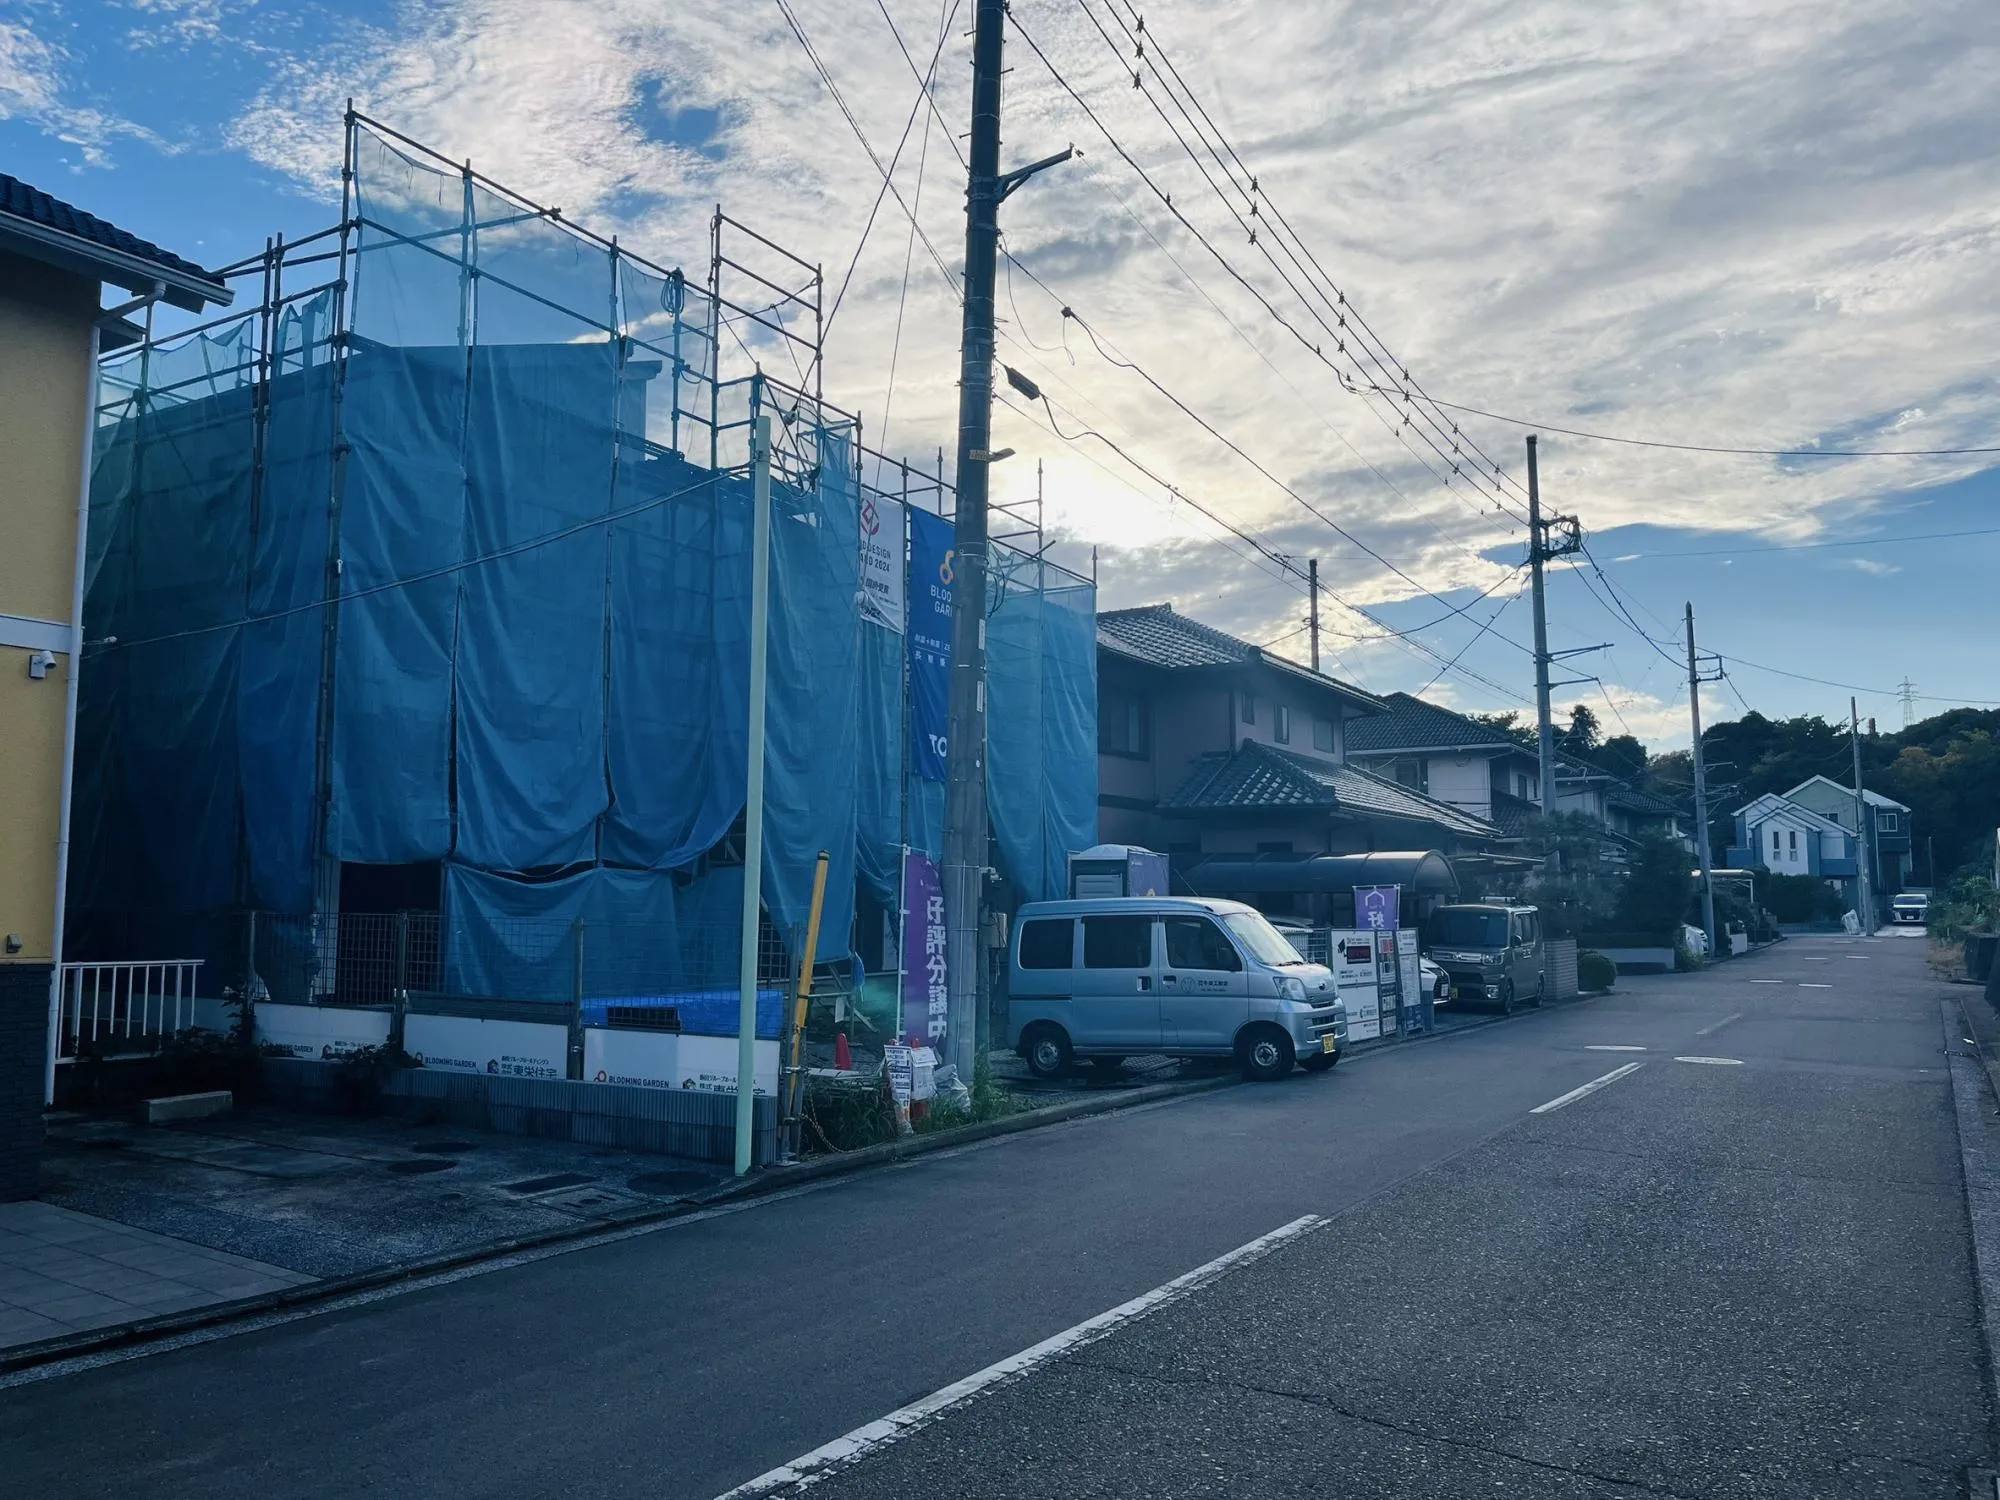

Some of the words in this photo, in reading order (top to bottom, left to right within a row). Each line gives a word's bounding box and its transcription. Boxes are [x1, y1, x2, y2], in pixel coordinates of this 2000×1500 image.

[868, 543, 891, 560] DESIGN
[875, 558, 890, 573] 2024
[930, 584, 952, 602] BLOO
[934, 600, 953, 617] GAR
[928, 733, 947, 757] TO
[926, 896, 947, 1043] 好評分譲中
[424, 1056, 453, 1066] BLOOMING
[453, 1059, 477, 1068] GARDEN
[609, 1075, 641, 1086] BLOOMING
[642, 1079, 669, 1088] GARDEN
